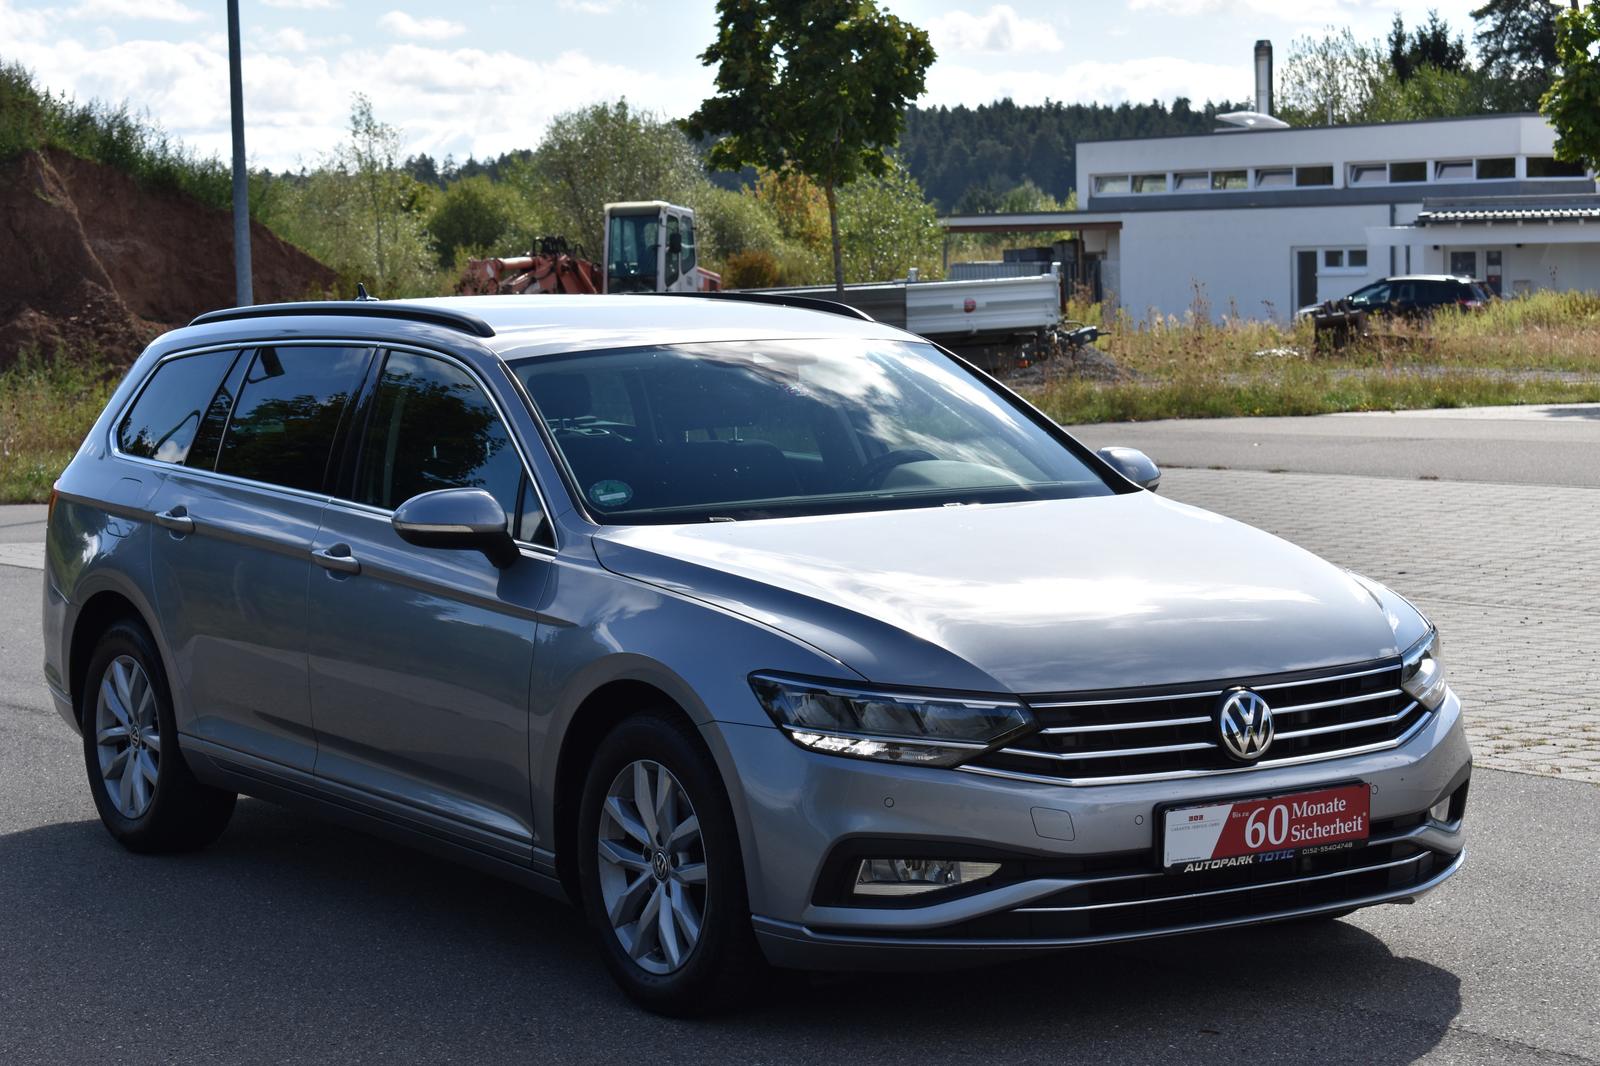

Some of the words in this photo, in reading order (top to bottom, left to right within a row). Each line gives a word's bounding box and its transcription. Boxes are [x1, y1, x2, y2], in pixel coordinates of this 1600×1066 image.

[1221, 691, 1274, 759] VW
[1232, 810, 1241, 819] Bis
[1292, 797, 1347, 819] Monate
[1245, 804, 1289, 849] 60
[1184, 854, 1255, 873] AUTOPARK
[1258, 849, 1296, 863] TOTIC
